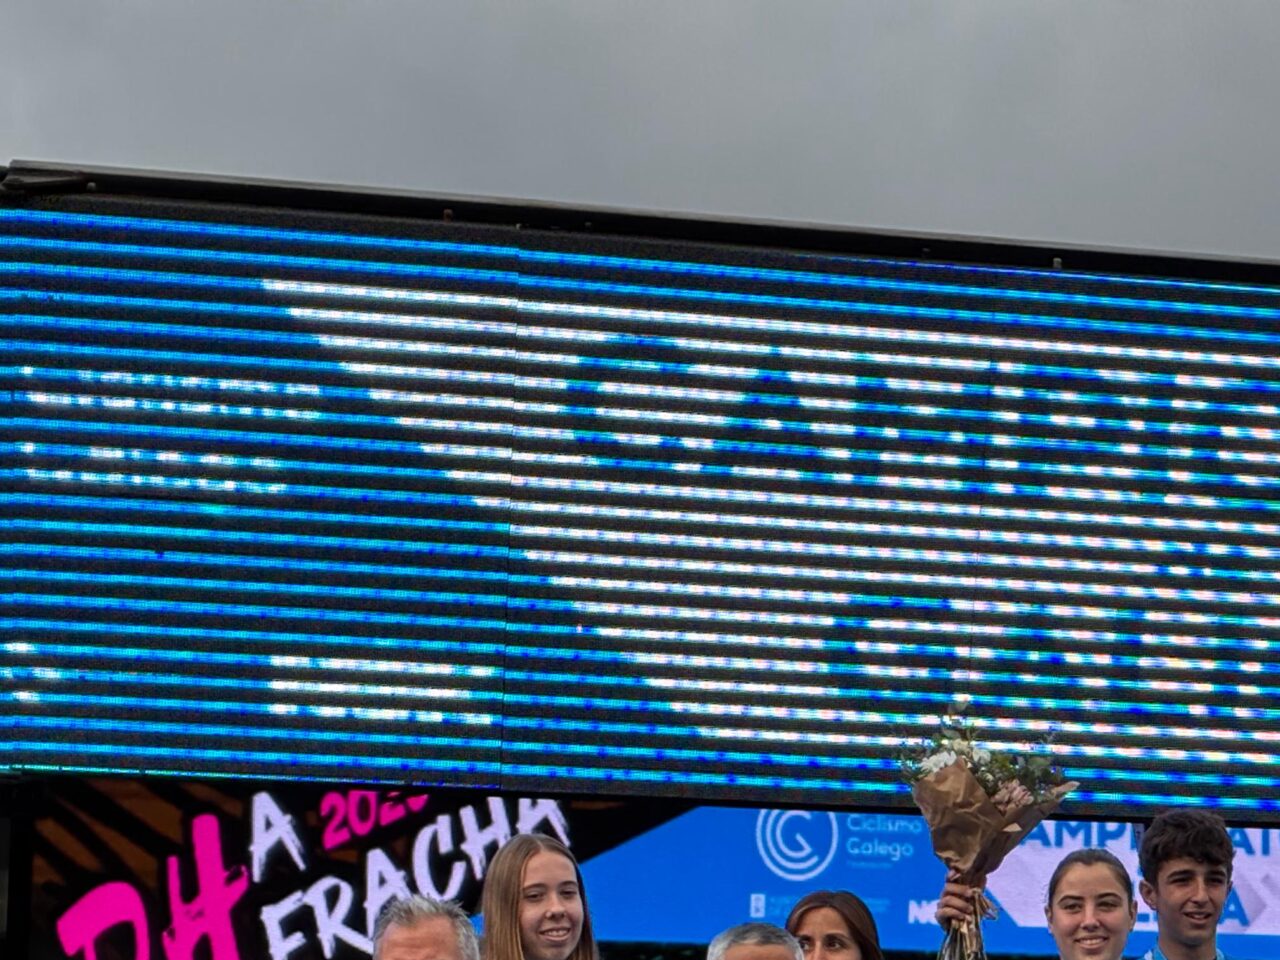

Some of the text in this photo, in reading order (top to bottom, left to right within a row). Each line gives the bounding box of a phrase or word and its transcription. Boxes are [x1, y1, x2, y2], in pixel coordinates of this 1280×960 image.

[249, 791, 307, 884] A
[320, 790, 430, 850] 202
[846, 814, 923, 833] Ciclismo
[846, 837, 914, 861] Galego
